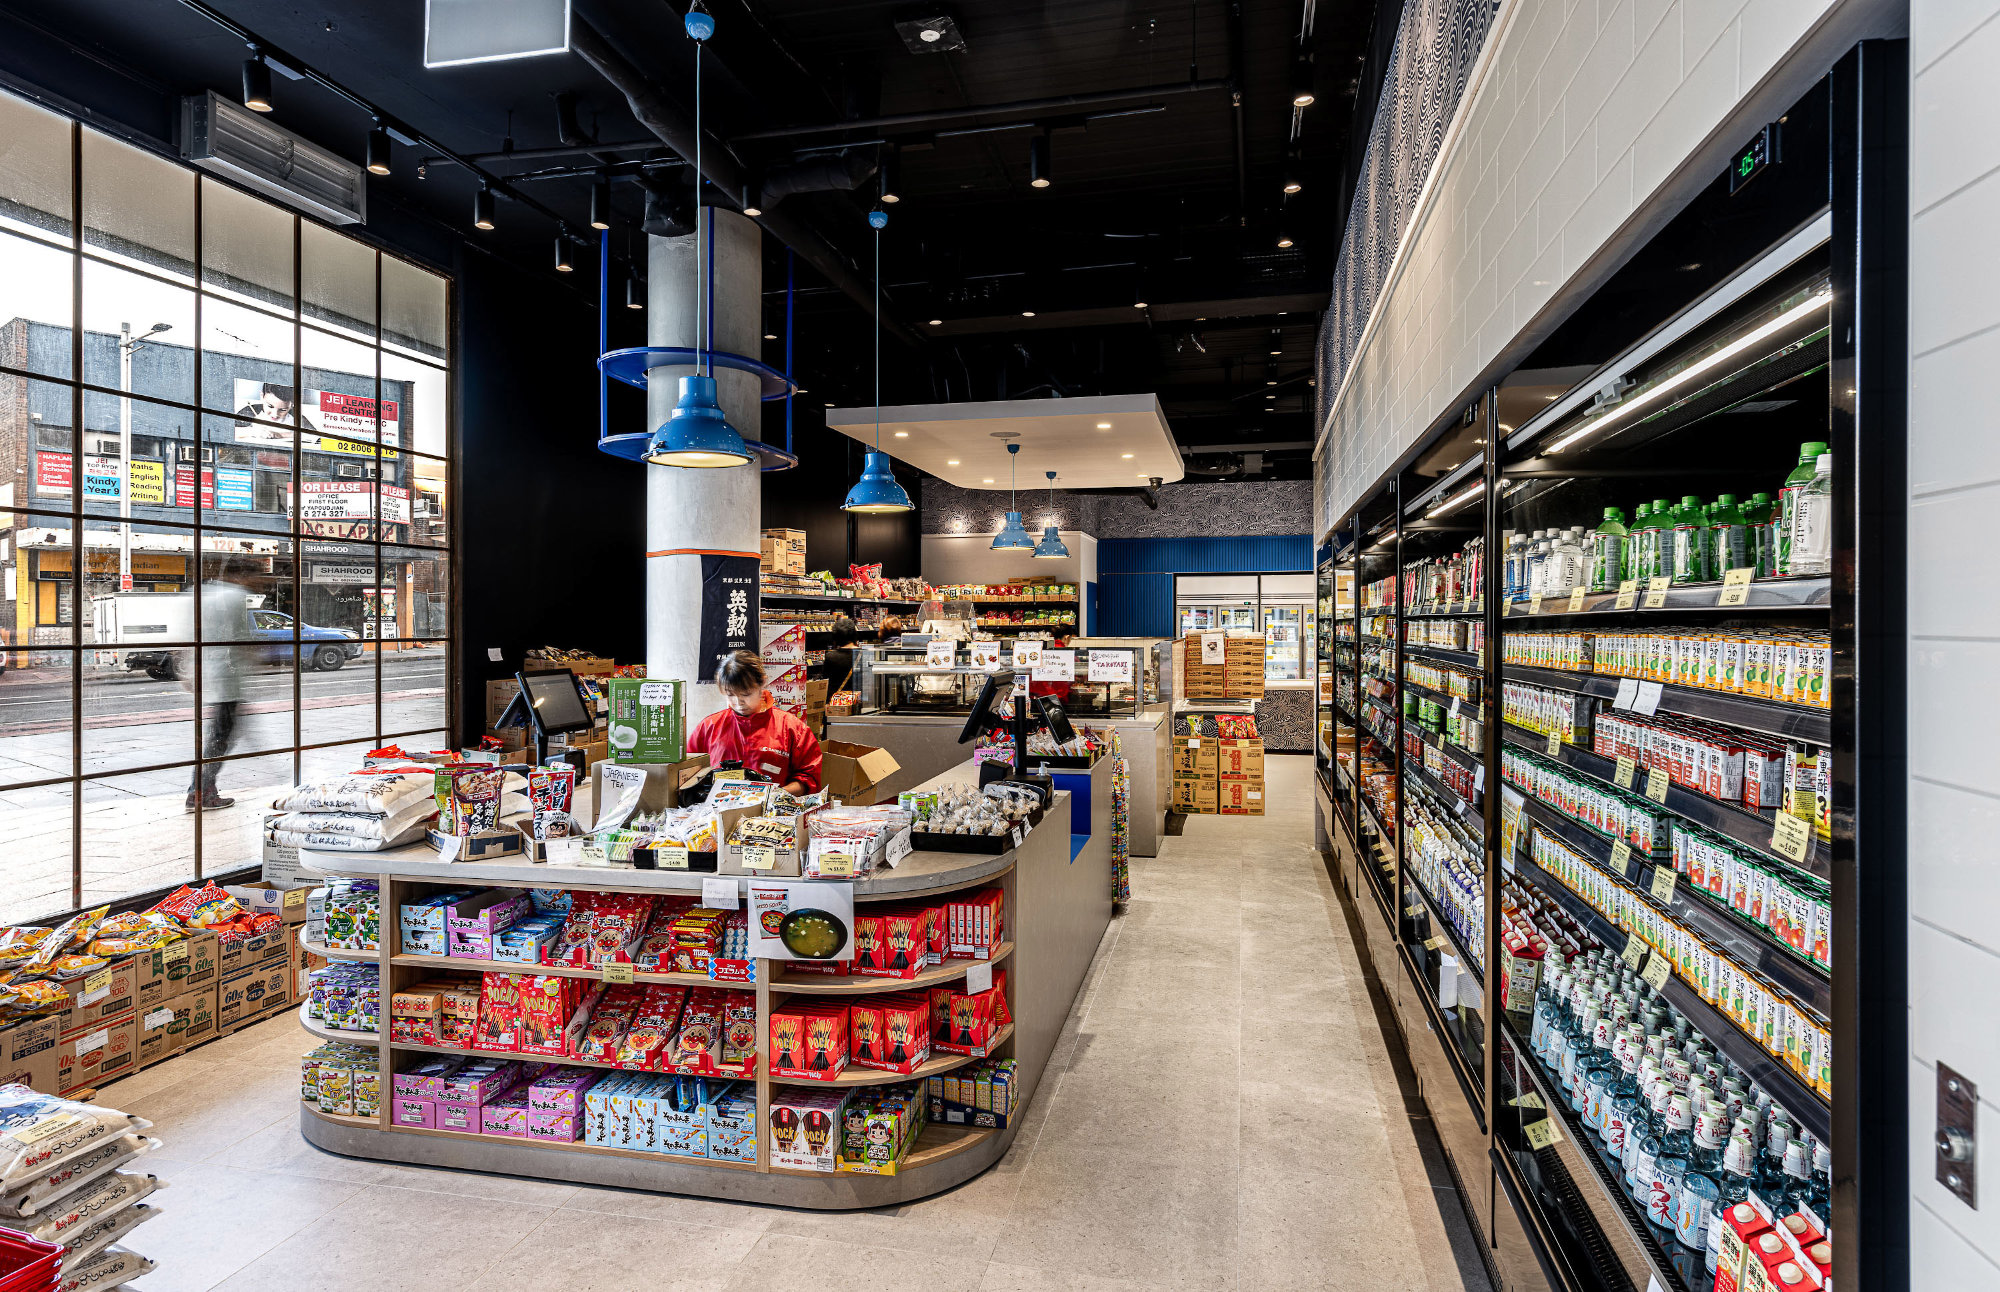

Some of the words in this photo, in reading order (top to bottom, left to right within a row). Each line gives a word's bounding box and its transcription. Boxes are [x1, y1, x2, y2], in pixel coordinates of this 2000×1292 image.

[326, 395, 344, 405] JEI
[346, 399, 393, 412] LEARNNG
[324, 413, 338, 421] Pre
[340, 416, 363, 425] Kindy
[370, 419, 387, 428] HC
[86, 476, 117, 487] Kindy
[130, 472, 160, 481] English
[130, 482, 163, 491] Reading
[303, 484, 321, 493] OR
[323, 483, 361, 493] LEASE
[305, 545, 349, 553] SHAHROOD
[320, 567, 373, 575] SHAHROOD
[604, 768, 639, 782] JAPANESE
[611, 779, 625, 790] TEA
[194, 957, 215, 972] 60g
[224, 989, 245, 1004] 60g
[193, 1010, 213, 1024] 60g
[58, 1054, 77, 1069] 0g
[1610, 1107, 1627, 1122] HAT
